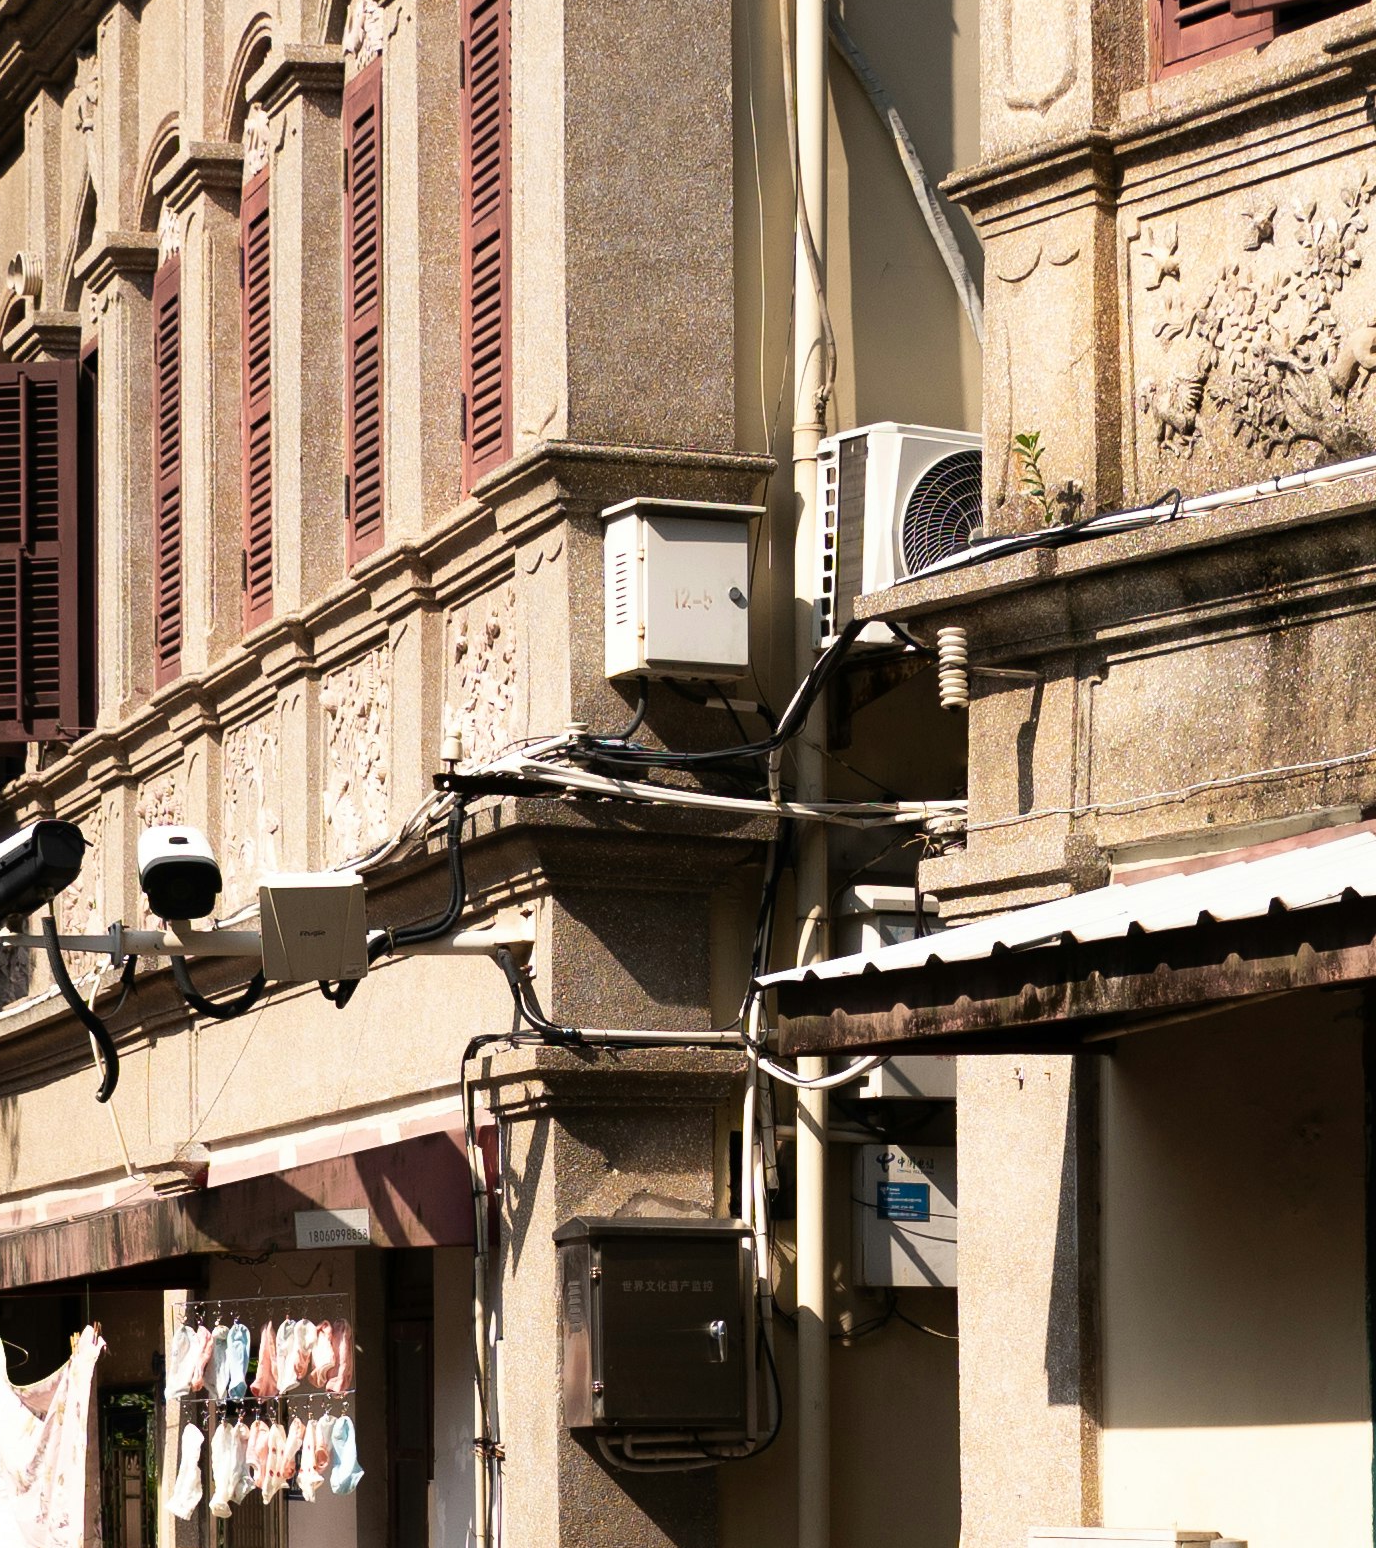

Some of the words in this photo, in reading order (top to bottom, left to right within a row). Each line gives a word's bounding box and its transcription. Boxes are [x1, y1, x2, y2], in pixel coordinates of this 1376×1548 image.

[622, 1279, 714, 1293] 世界文化遗产监控
